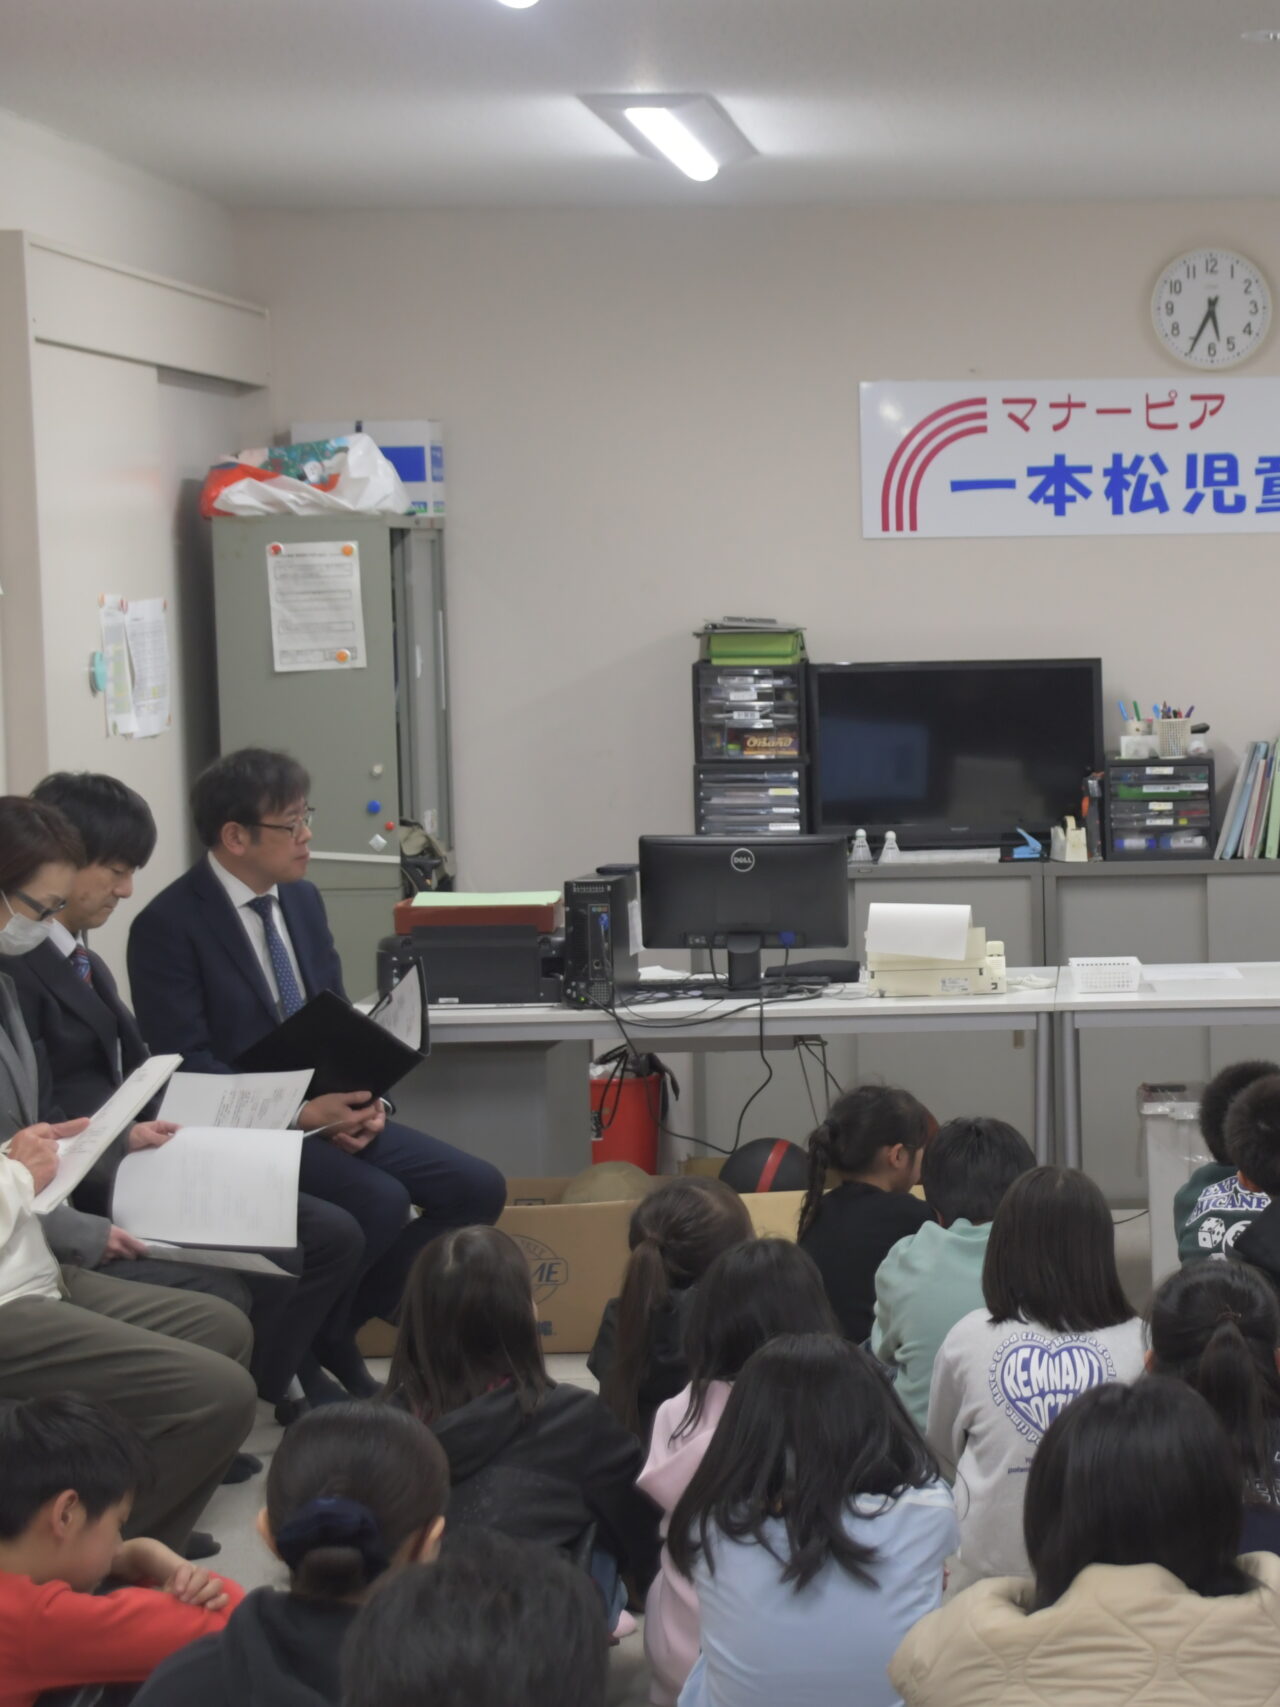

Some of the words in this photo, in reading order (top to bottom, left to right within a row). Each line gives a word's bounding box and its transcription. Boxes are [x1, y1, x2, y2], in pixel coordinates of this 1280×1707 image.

[1185, 264, 1196, 279] 11
[1205, 258, 1218, 274] 12
[1230, 263, 1234, 279] 1
[1169, 280, 1182, 295] 10
[1243, 279, 1252, 295] 2
[1164, 301, 1174, 316] 9
[1250, 300, 1258, 315] 3
[1170, 322, 1180, 337] 8
[1243, 322, 1252, 336] 4
[1207, 342, 1216, 357] 6
[1227, 337, 1235, 351] 5
[1002, 391, 1226, 433] マナーピア
[733, 856, 753, 864] DELL
[1052, 1333, 1087, 1349] Have
[1003, 1347, 1101, 1399] REMNANT
[1015, 1392, 1073, 1431] DOCT
